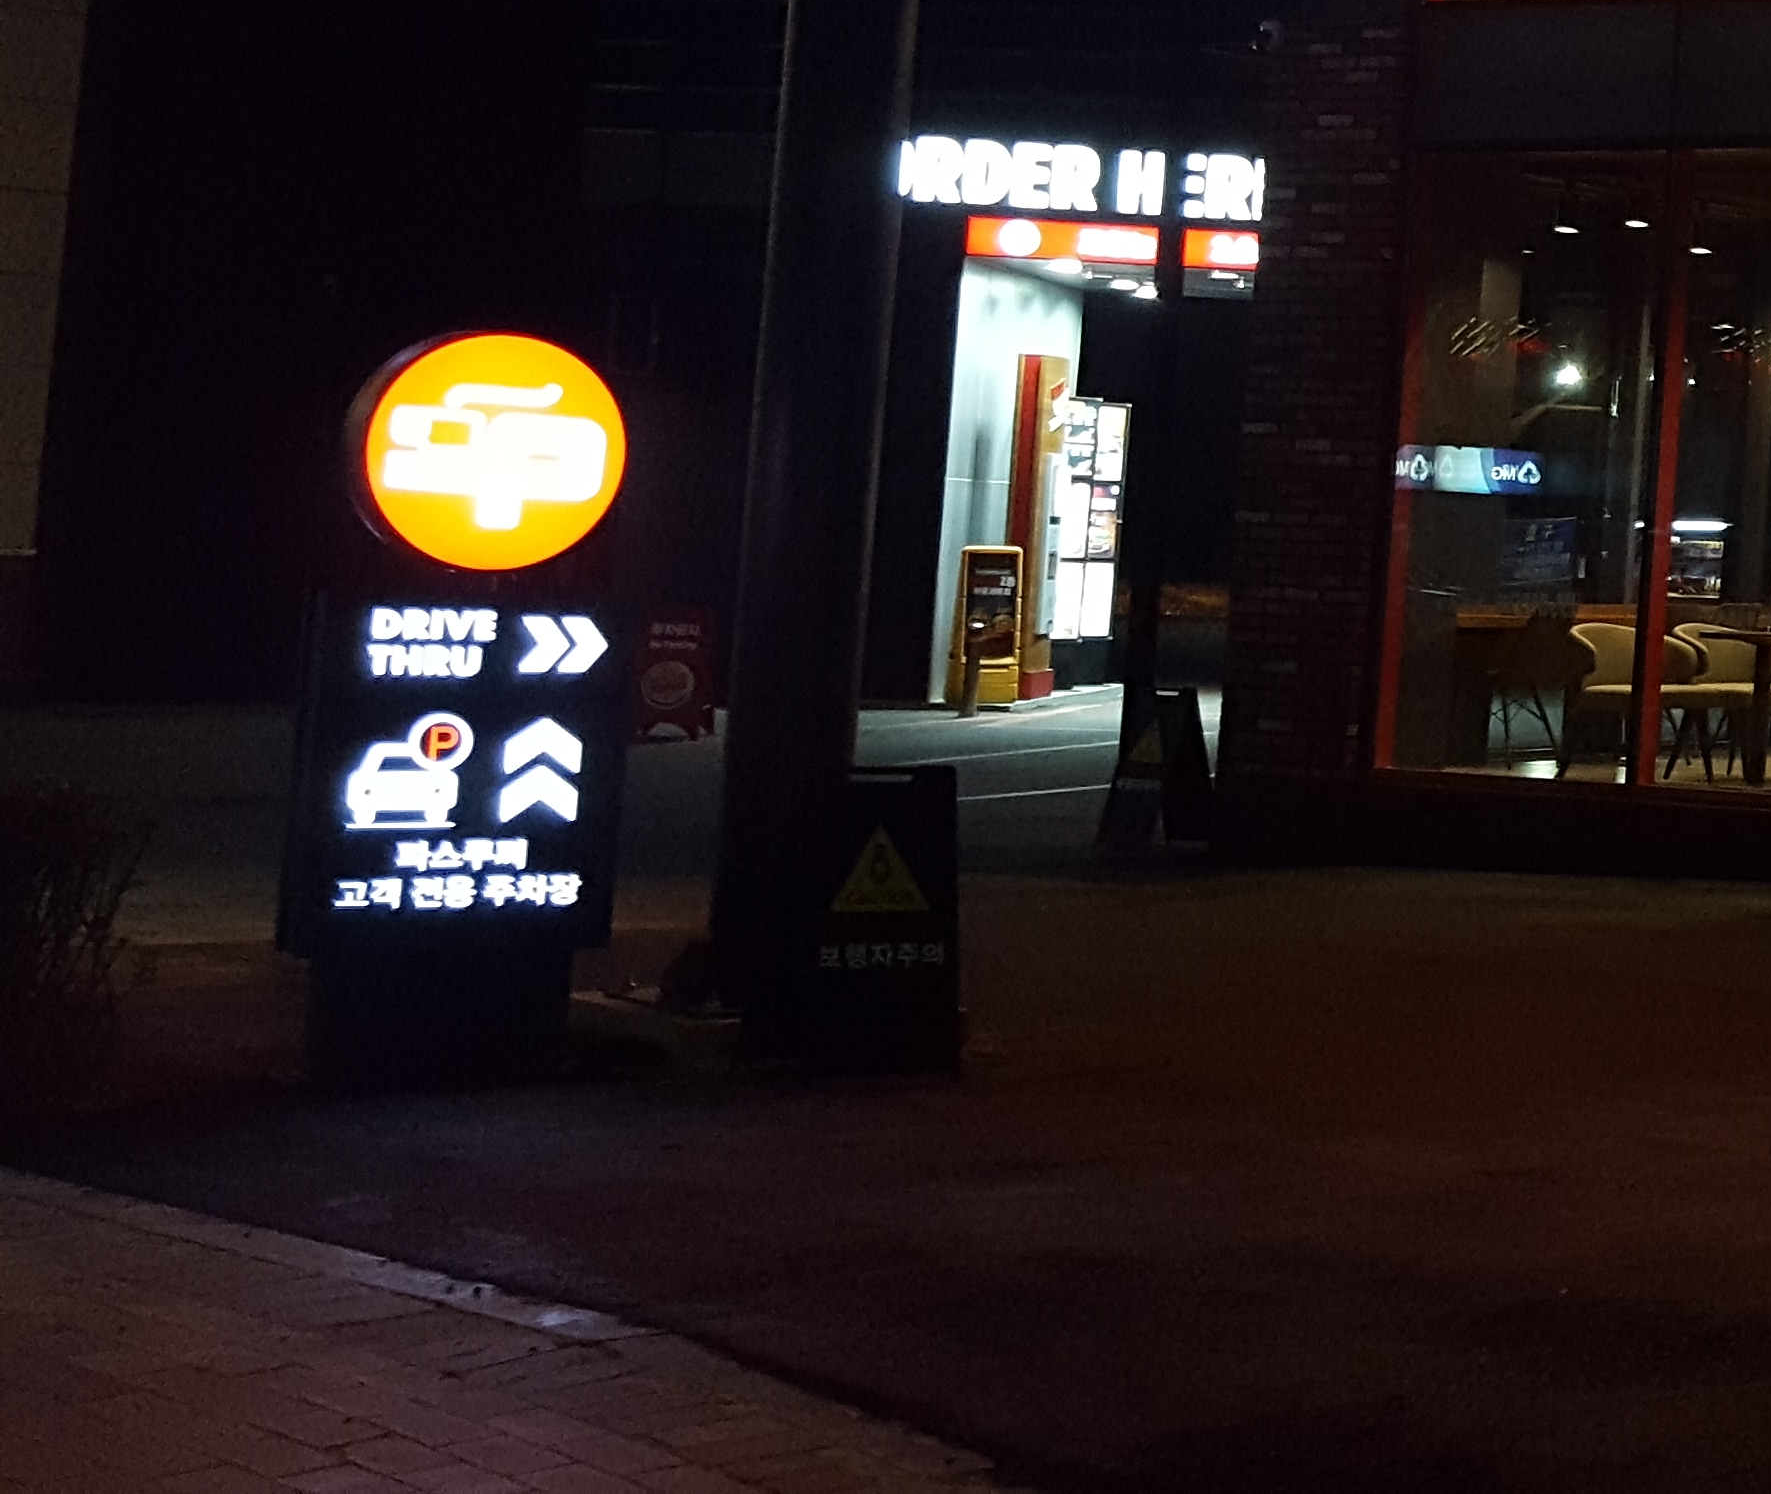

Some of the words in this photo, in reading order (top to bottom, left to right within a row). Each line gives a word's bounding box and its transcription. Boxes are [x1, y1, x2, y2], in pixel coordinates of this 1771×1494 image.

[899, 135, 1100, 212] RDER
[369, 607, 499, 643] DRIVE
[366, 643, 483, 678] THRU
[334, 877, 403, 909] 고객
[411, 875, 478, 908] 전용
[483, 874, 583, 907] 주차장
